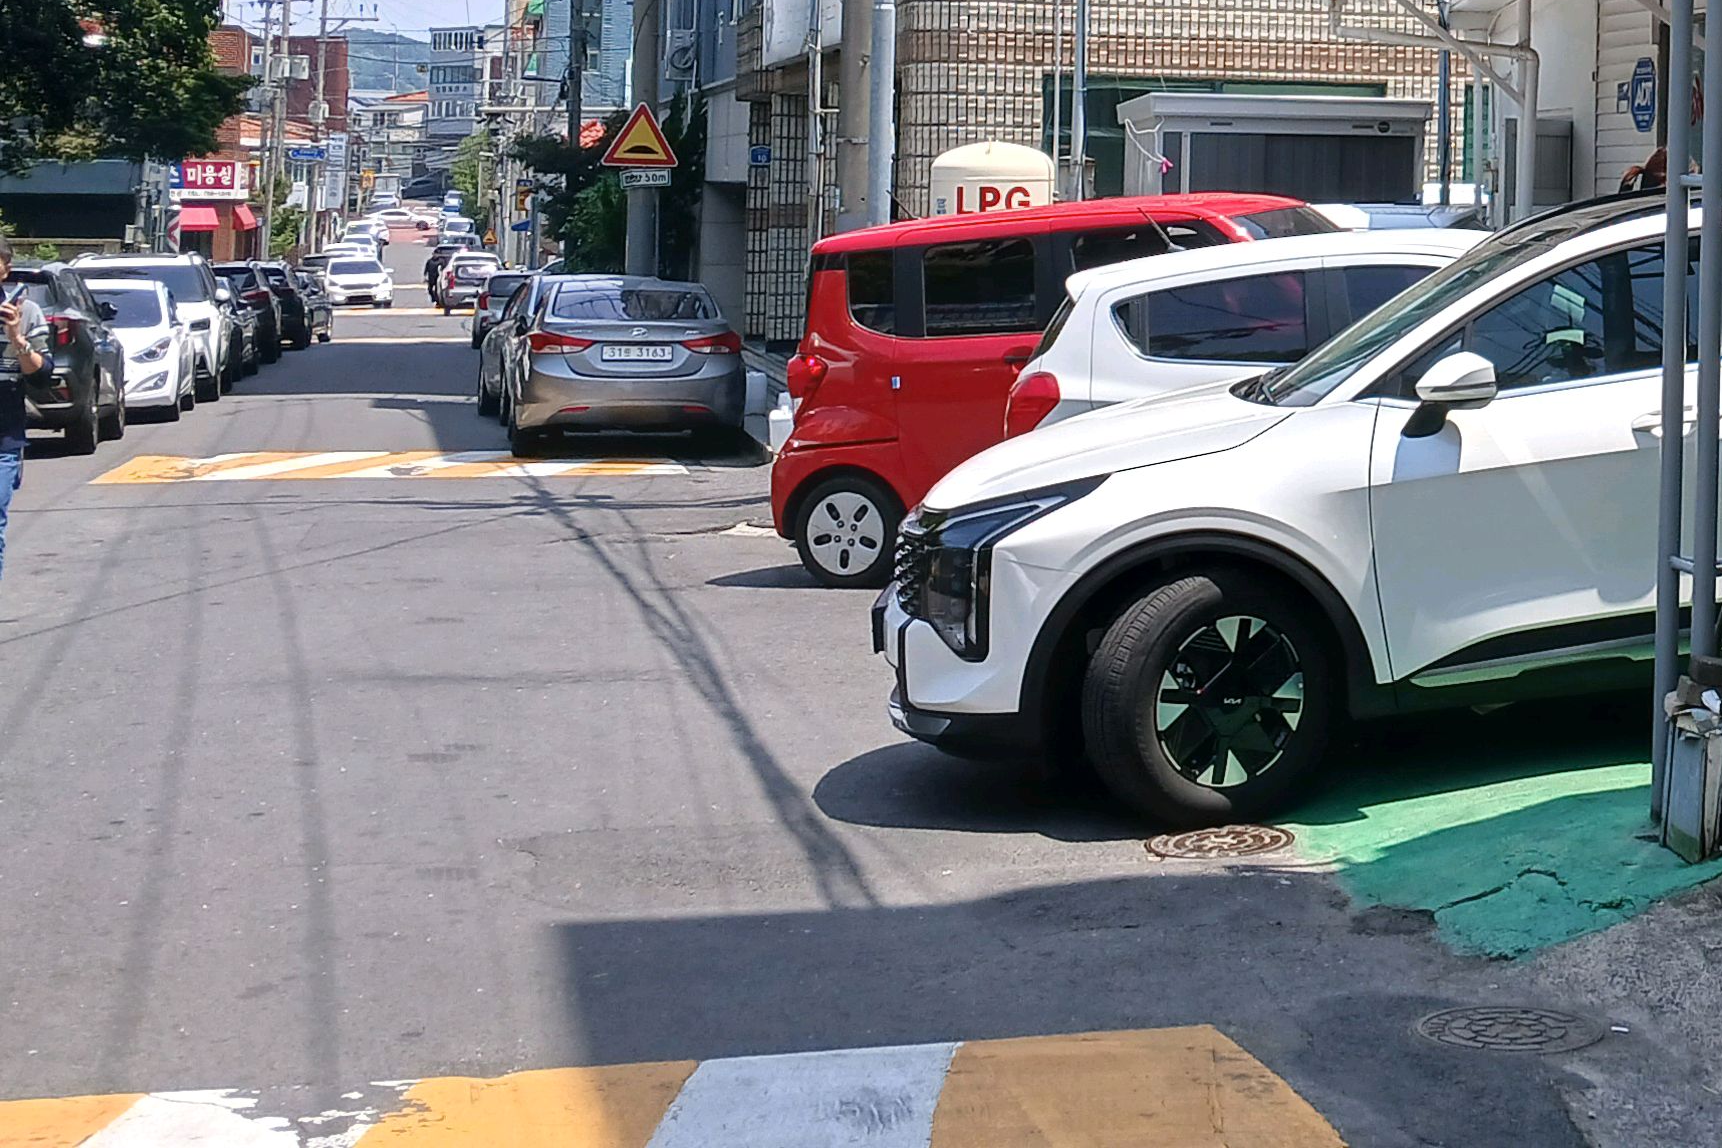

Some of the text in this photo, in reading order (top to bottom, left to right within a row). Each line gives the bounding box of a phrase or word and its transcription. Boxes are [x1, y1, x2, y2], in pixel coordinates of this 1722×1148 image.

[1634, 80, 1653, 107] ADT
[186, 164, 232, 186] 미용실
[956, 186, 1031, 215] LPG
